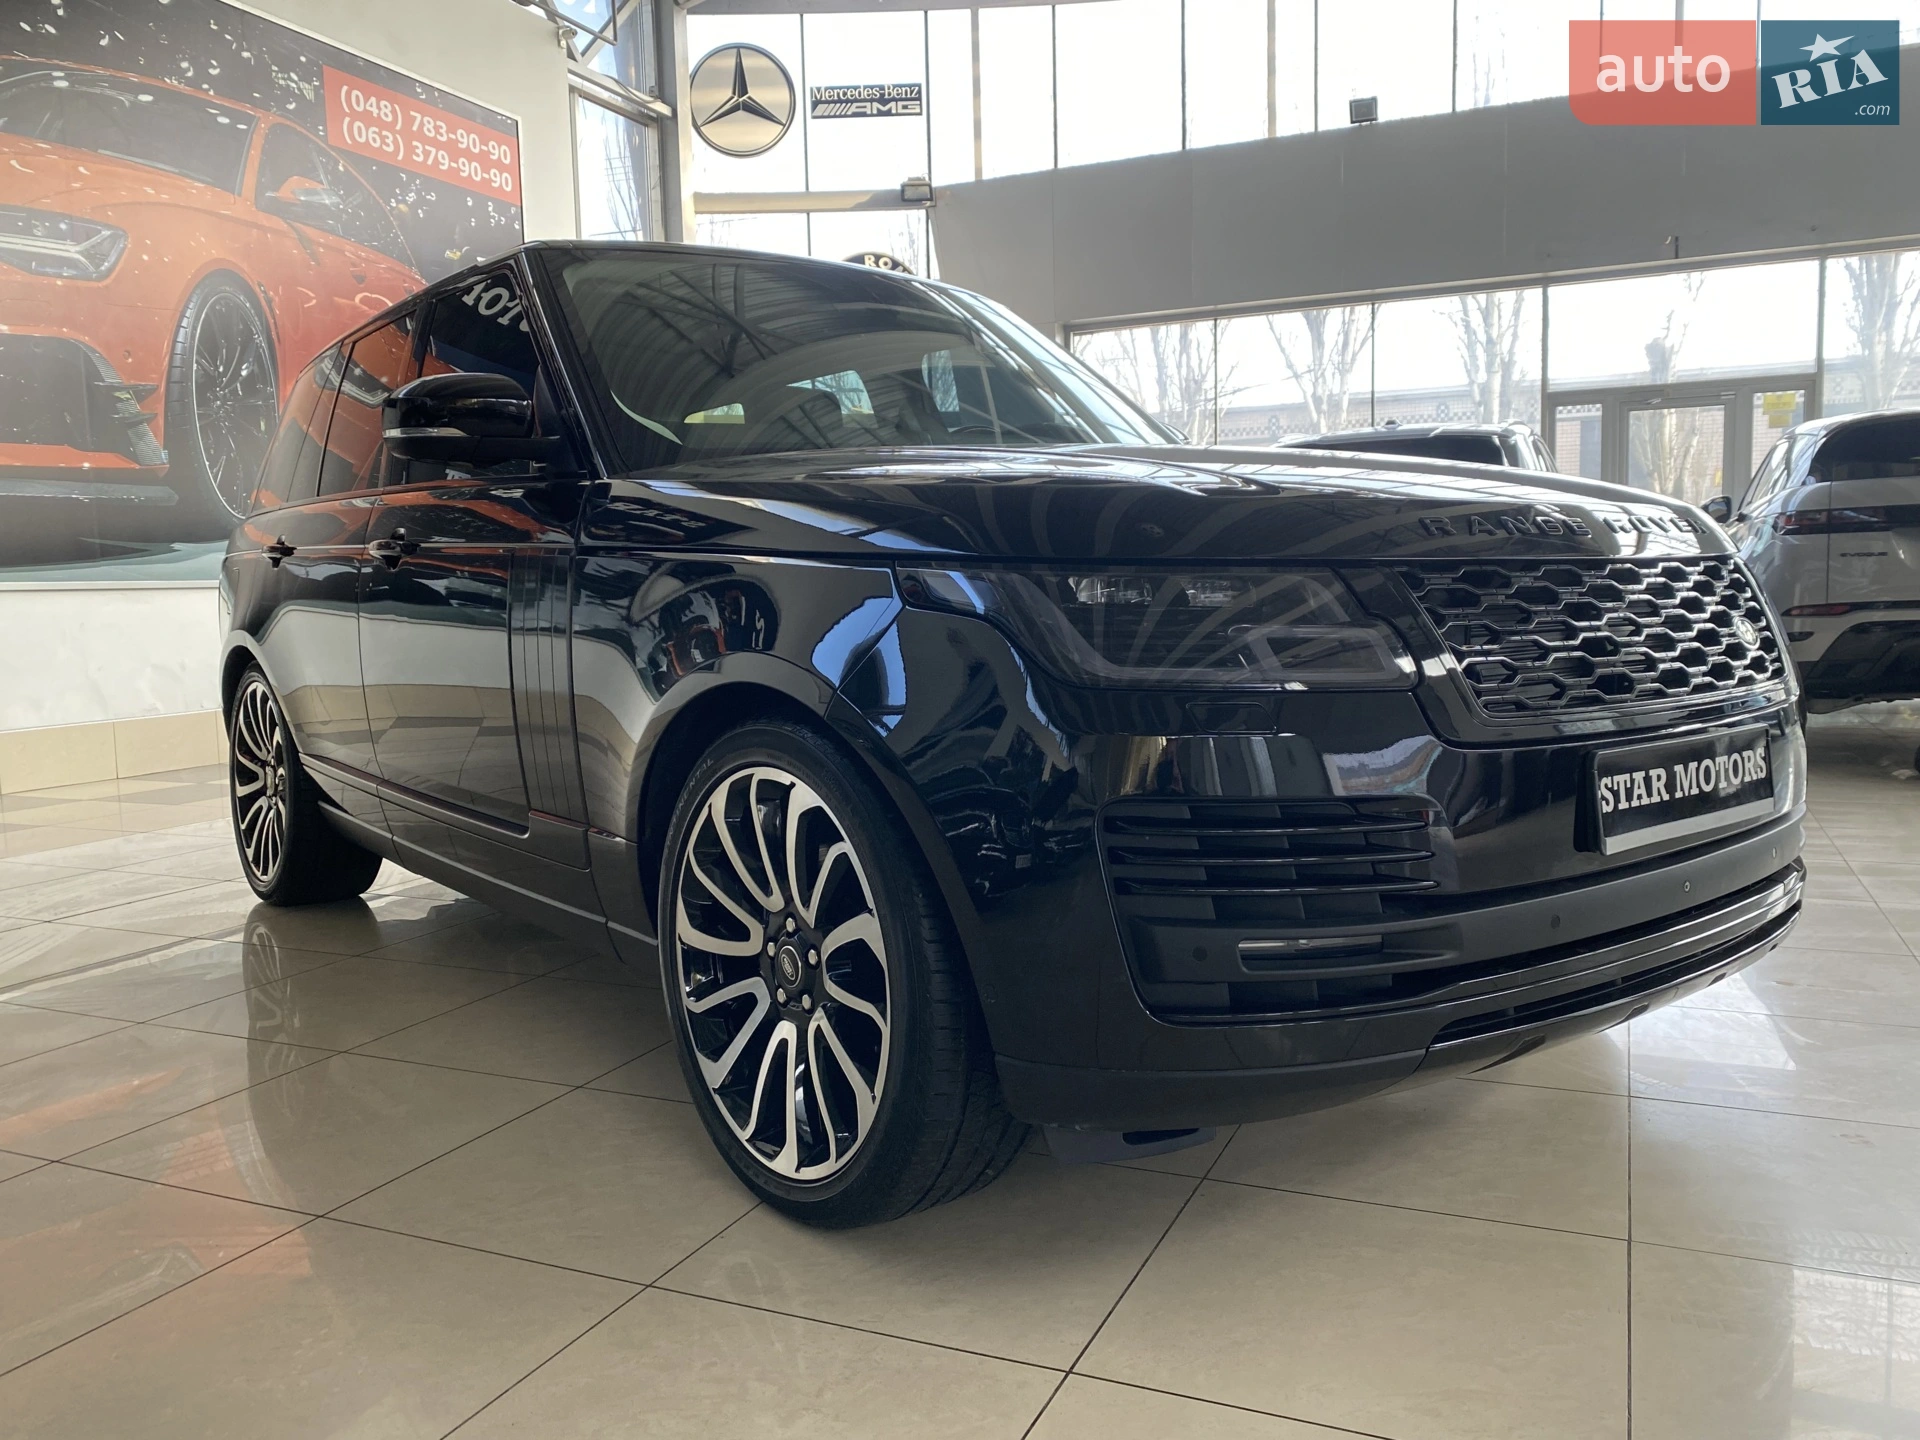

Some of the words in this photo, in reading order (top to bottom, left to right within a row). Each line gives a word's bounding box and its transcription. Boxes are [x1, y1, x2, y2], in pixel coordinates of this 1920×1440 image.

[811, 85, 919, 101] Mercedes-Benz
[846, 100, 921, 115] AMG
[340, 85, 402, 130] (048)
[409, 111, 511, 165] 783-90-90
[342, 117, 404, 160] (063)
[411, 141, 512, 192] 379-90-90
[1418, 514, 1592, 538] RANGE
[1602, 514, 1709, 536] ROVER
[1600, 767, 1670, 814] STAR
[1673, 746, 1767, 799] MOTORS
